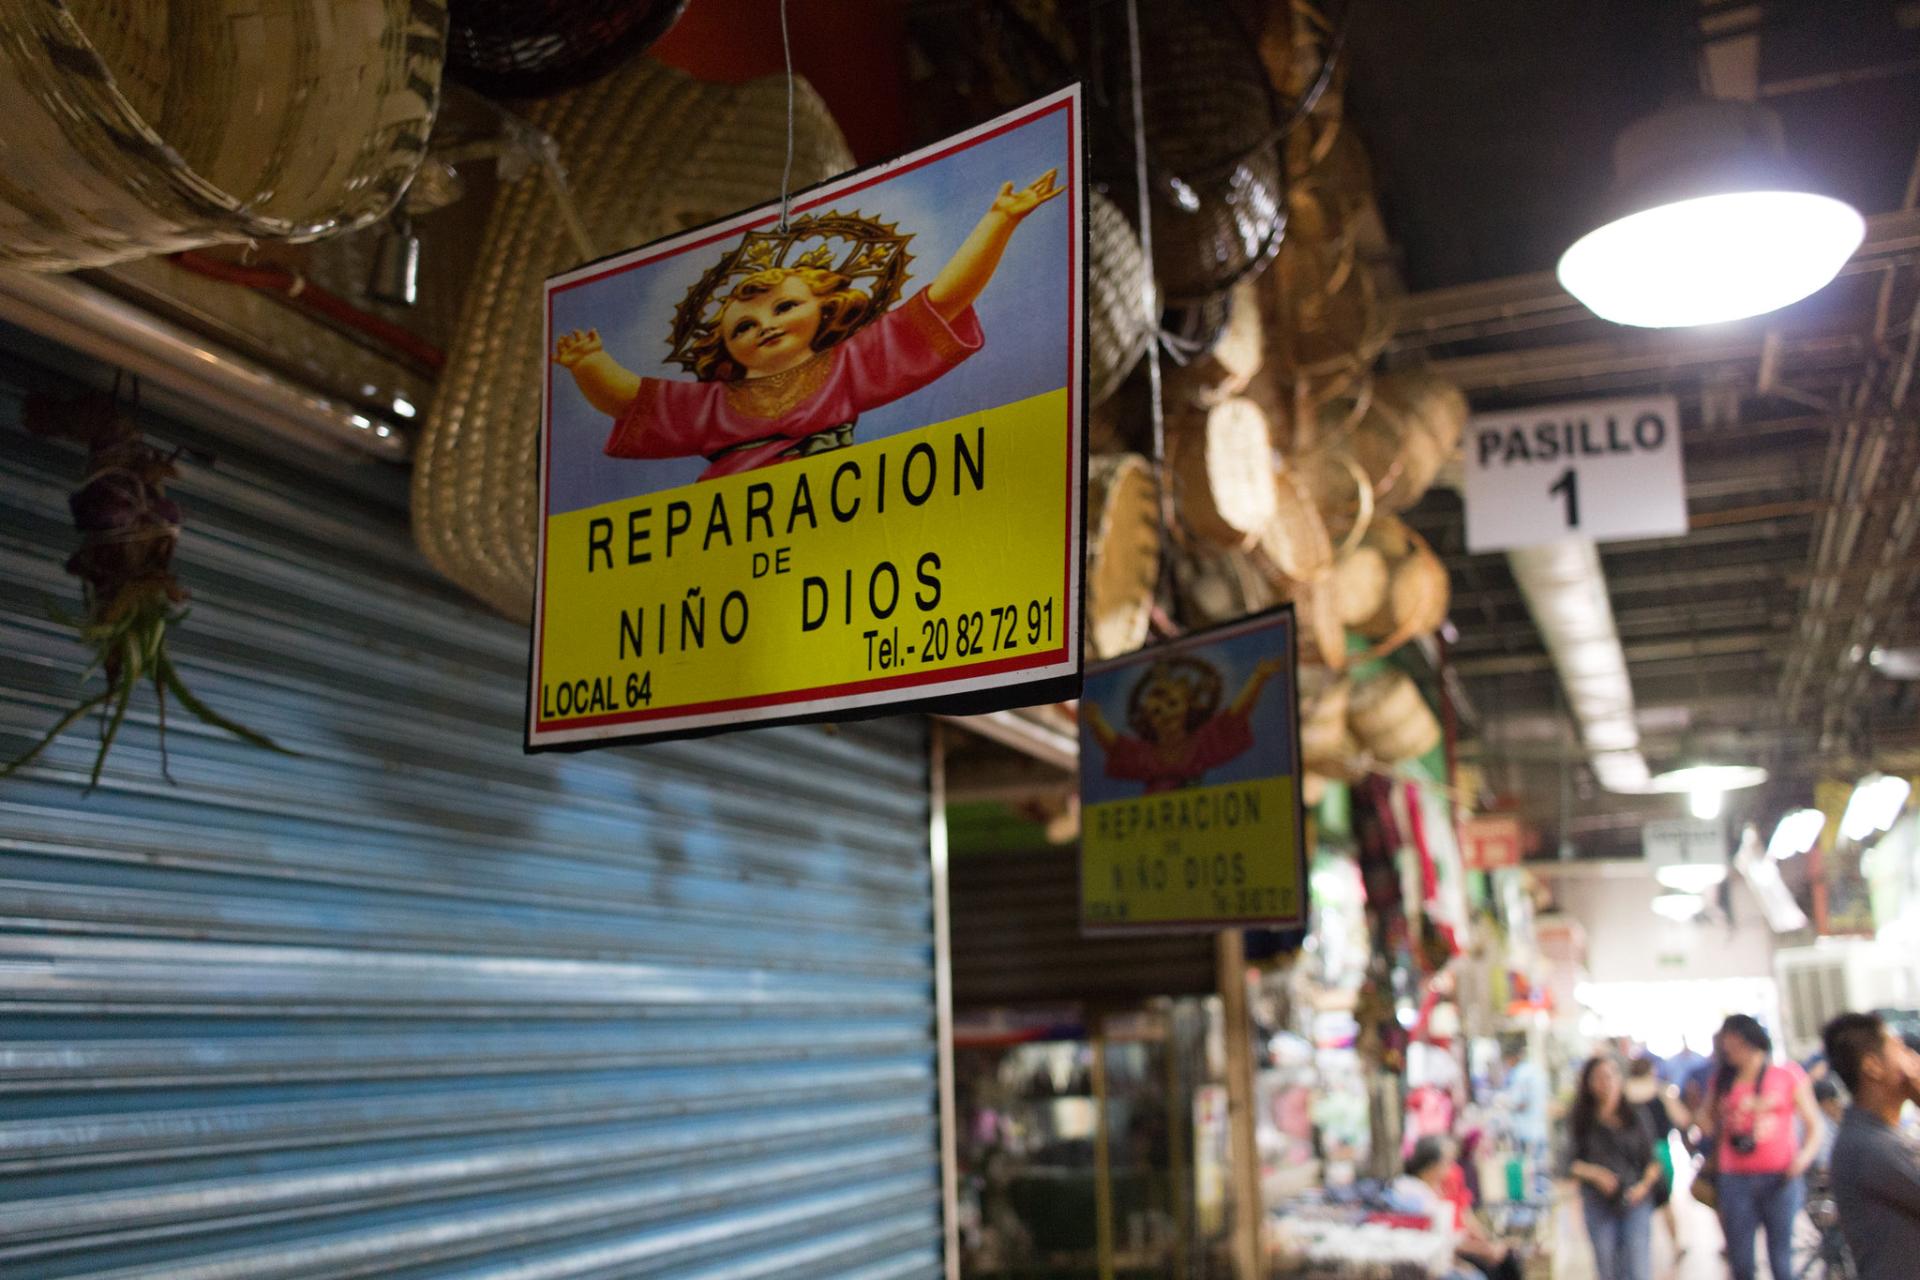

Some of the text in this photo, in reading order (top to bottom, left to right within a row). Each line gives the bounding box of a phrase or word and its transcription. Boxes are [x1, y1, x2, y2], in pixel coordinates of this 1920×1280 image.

[1477, 413, 1665, 467] PASILLO
[588, 426, 985, 573] REPARACION
[1549, 466, 1579, 528] 1
[752, 546, 791, 579] DE
[619, 551, 941, 661] NIÑO DIOS
[863, 596, 1053, 671] Tel.- 20 82 72 91
[543, 670, 653, 719] LOCAL 64
